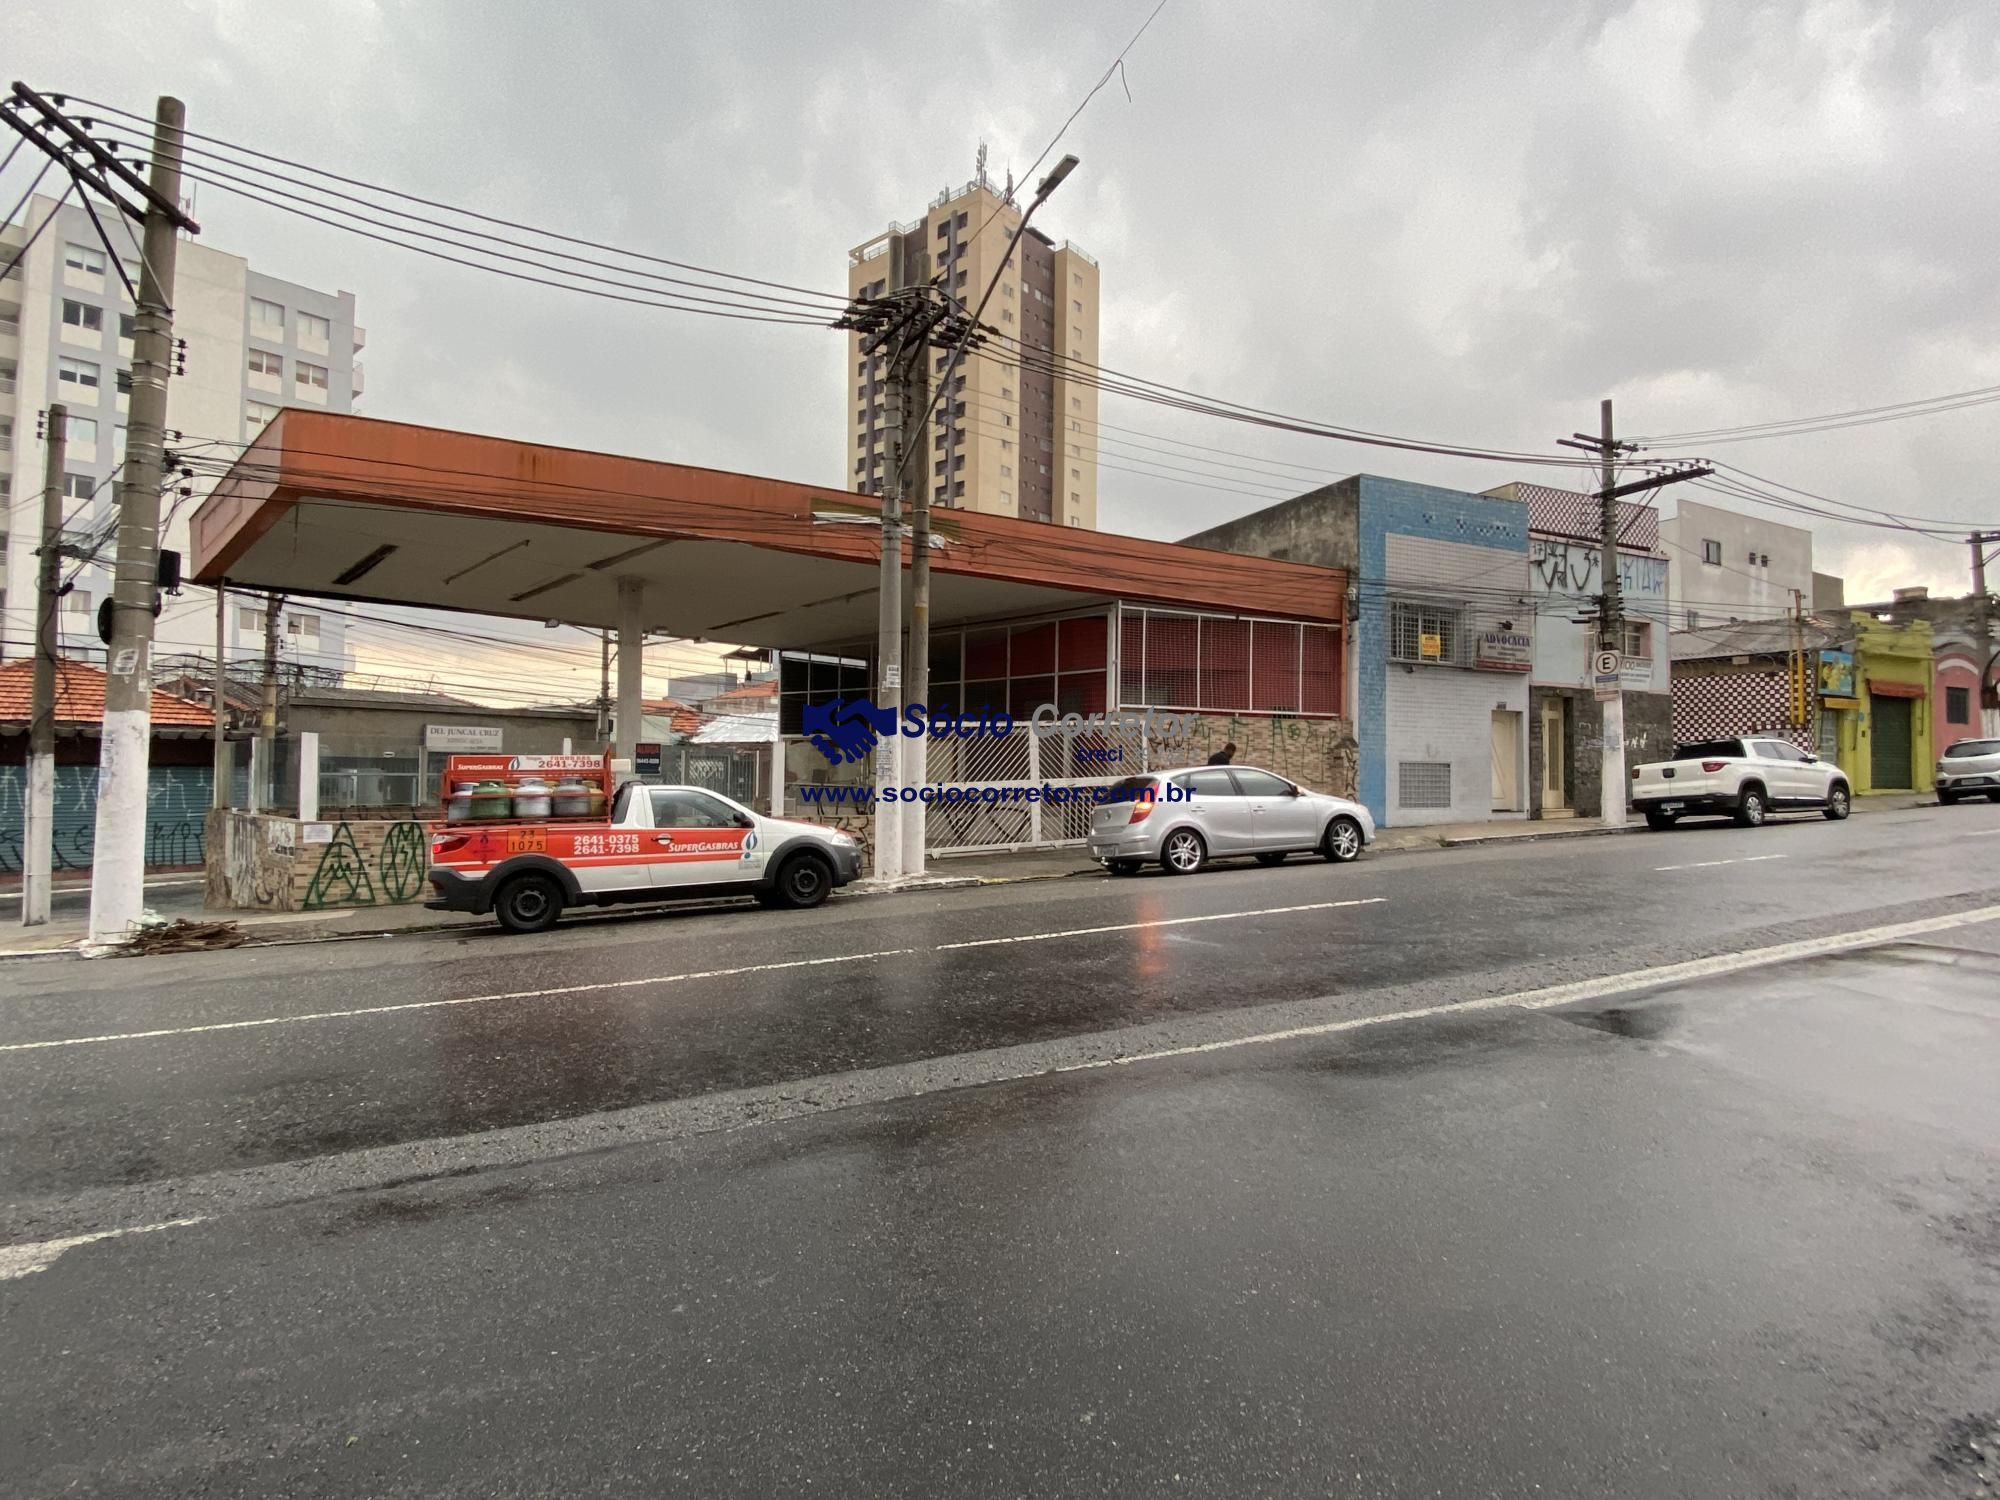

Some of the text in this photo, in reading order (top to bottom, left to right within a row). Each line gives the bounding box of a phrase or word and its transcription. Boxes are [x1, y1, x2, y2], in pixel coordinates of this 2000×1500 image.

[1485, 632, 1530, 647] ADVOCACIA
[1602, 657, 1611, 670] E
[430, 727, 445, 736] DEL
[479, 729, 500, 738] CRUZ
[538, 760, 601, 769] 2641-7398
[573, 834, 640, 845] 2641-0375
[511, 840, 543, 851] 1075
[573, 844, 640, 855] 2641-7398
